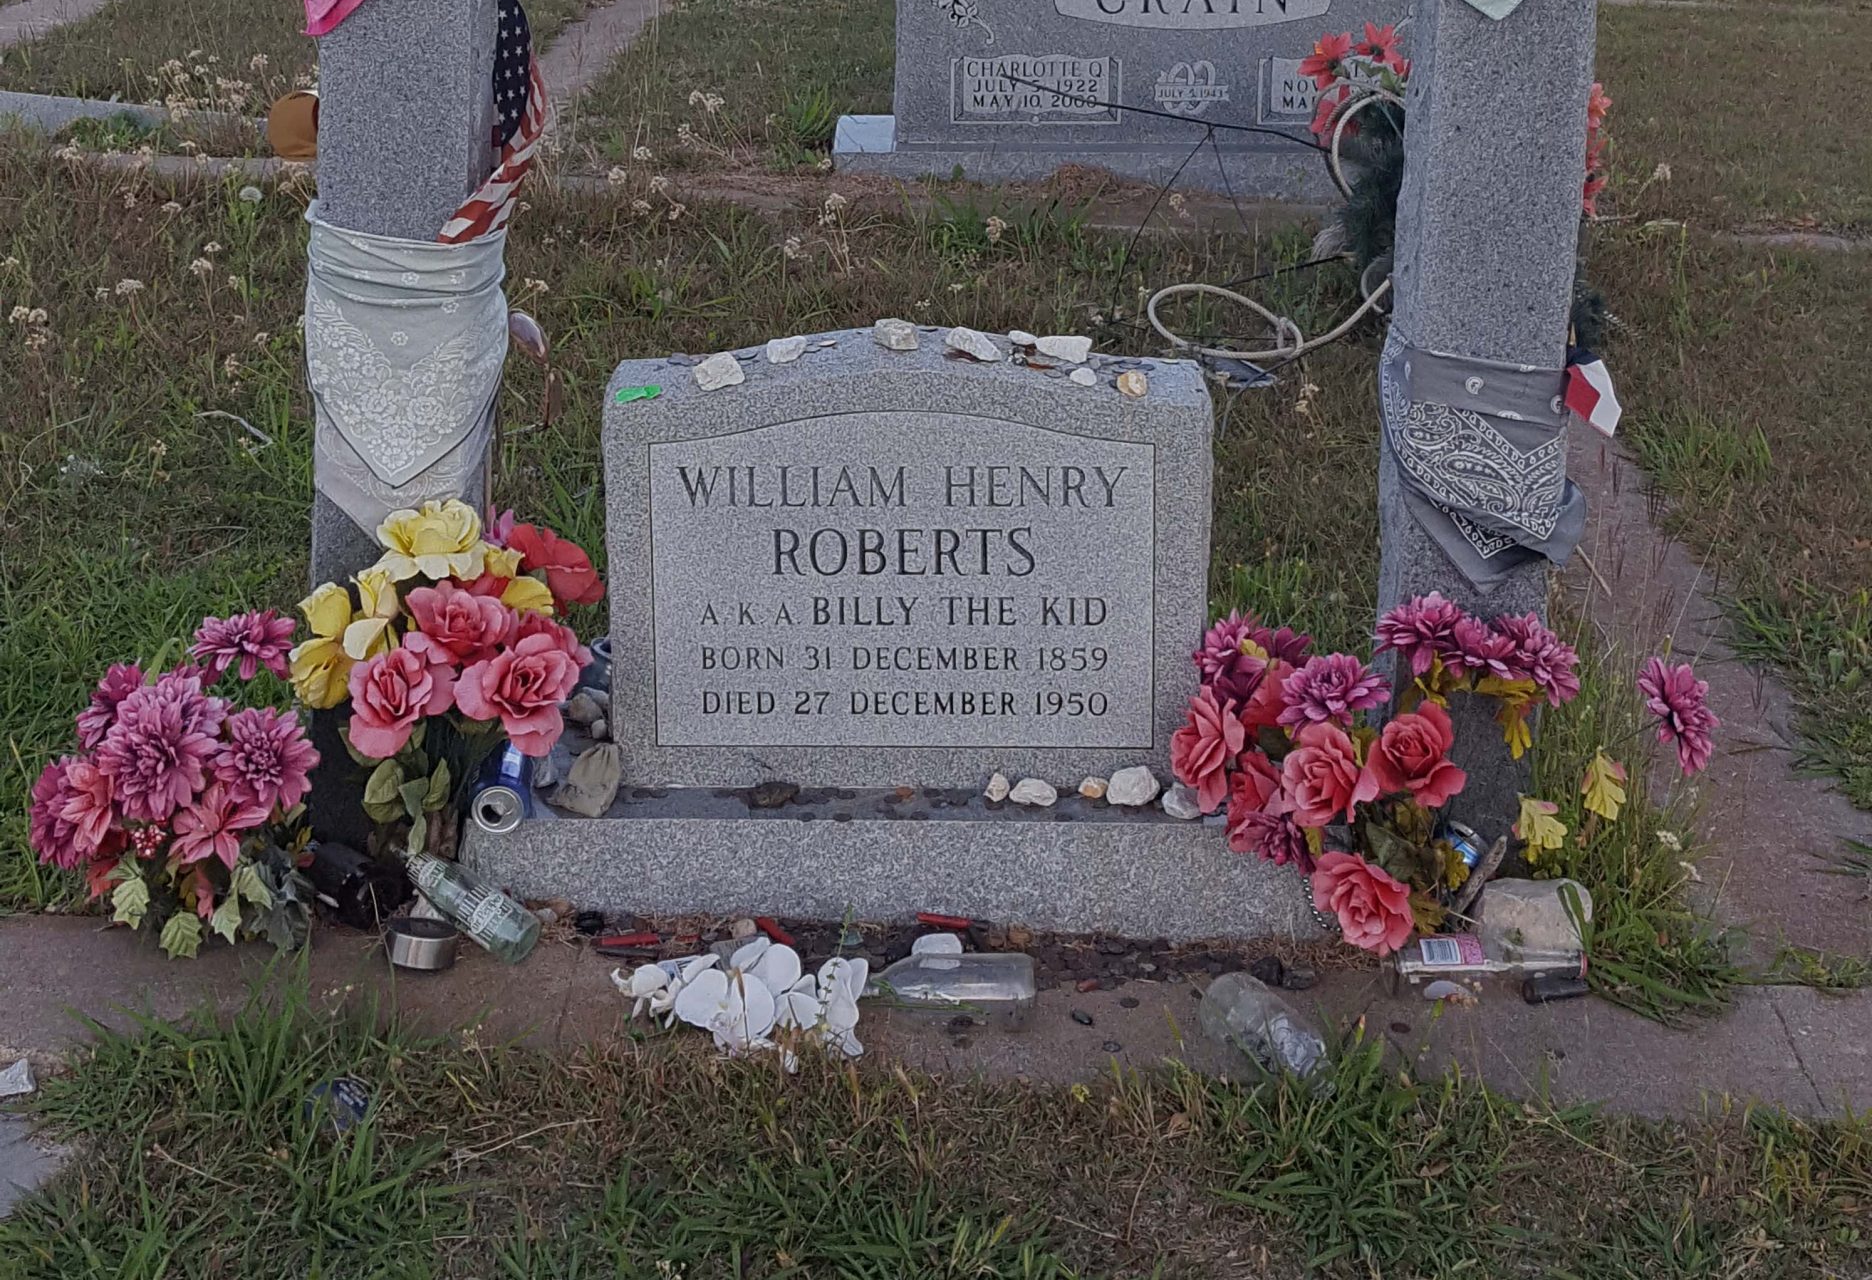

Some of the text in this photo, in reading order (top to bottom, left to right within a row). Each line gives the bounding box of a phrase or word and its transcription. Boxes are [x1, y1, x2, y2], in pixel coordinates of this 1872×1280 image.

[967, 61, 1081, 77] CHARLOTTE
[973, 79, 1018, 92] JULY
[1056, 79, 1098, 92] 1922
[1158, 88, 1182, 98] JULY
[973, 95, 1014, 107] MAY
[1051, 94, 1097, 108] 2000
[676, 465, 1128, 508] WILLIAM HENRY
[771, 526, 1036, 577] ROBERTS
[813, 596, 919, 626] BILLY
[941, 596, 1017, 627] THE
[1041, 596, 1108, 627] KID
[702, 645, 1109, 671] BORN 31 DECEMBER 1859
[702, 691, 1109, 716] DIED 27 DECEMBER 1950
